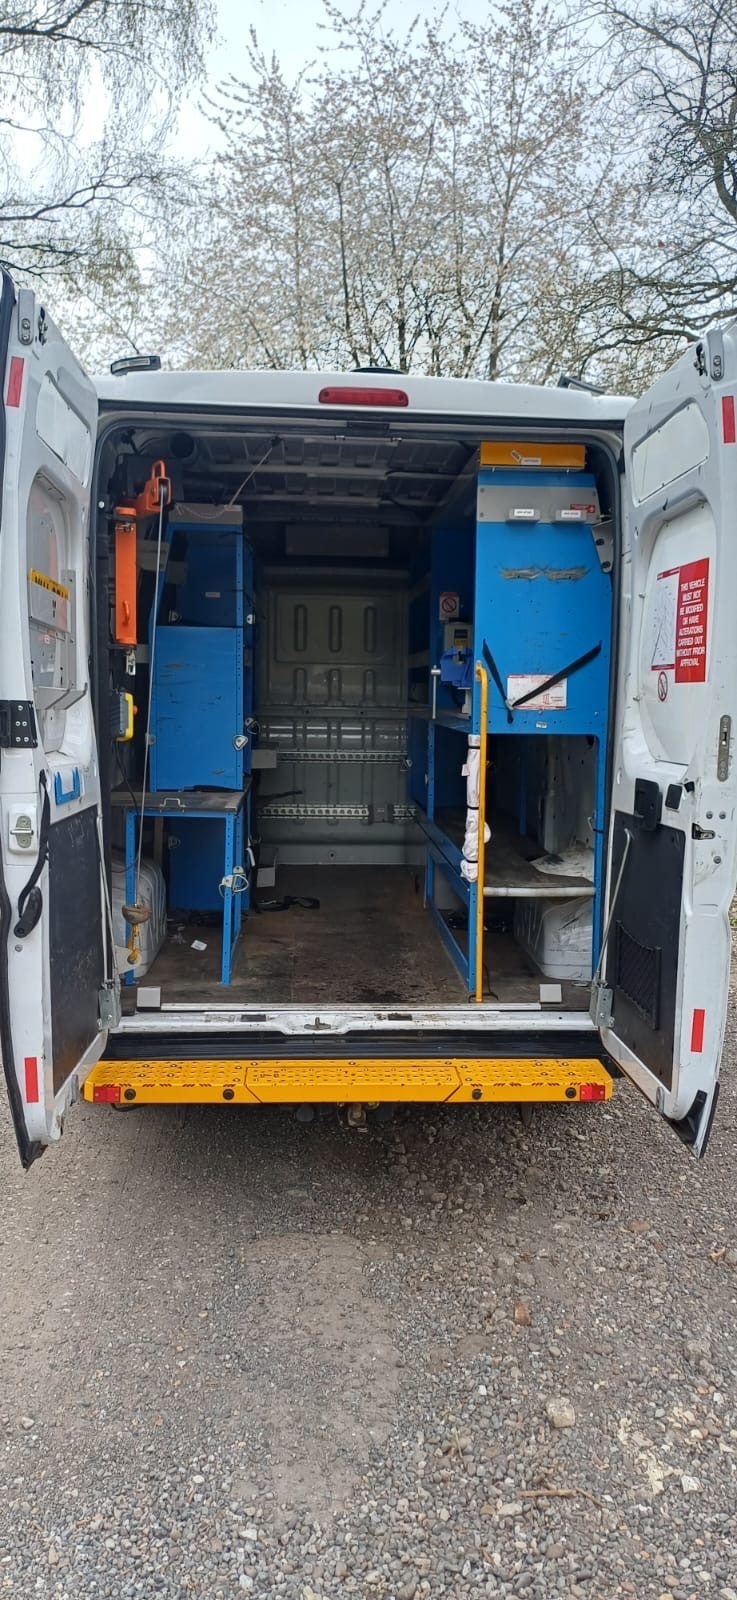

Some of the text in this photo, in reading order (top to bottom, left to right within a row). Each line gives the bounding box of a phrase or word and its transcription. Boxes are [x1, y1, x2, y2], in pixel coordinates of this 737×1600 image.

[689, 578, 705, 589] VEHICLE
[693, 590, 702, 600] NOT
[682, 615, 700, 625] OR HAVE
[694, 636, 703, 645] OUT
[692, 647, 705, 655] PRIOR
[680, 658, 700, 667] APPROVAL
